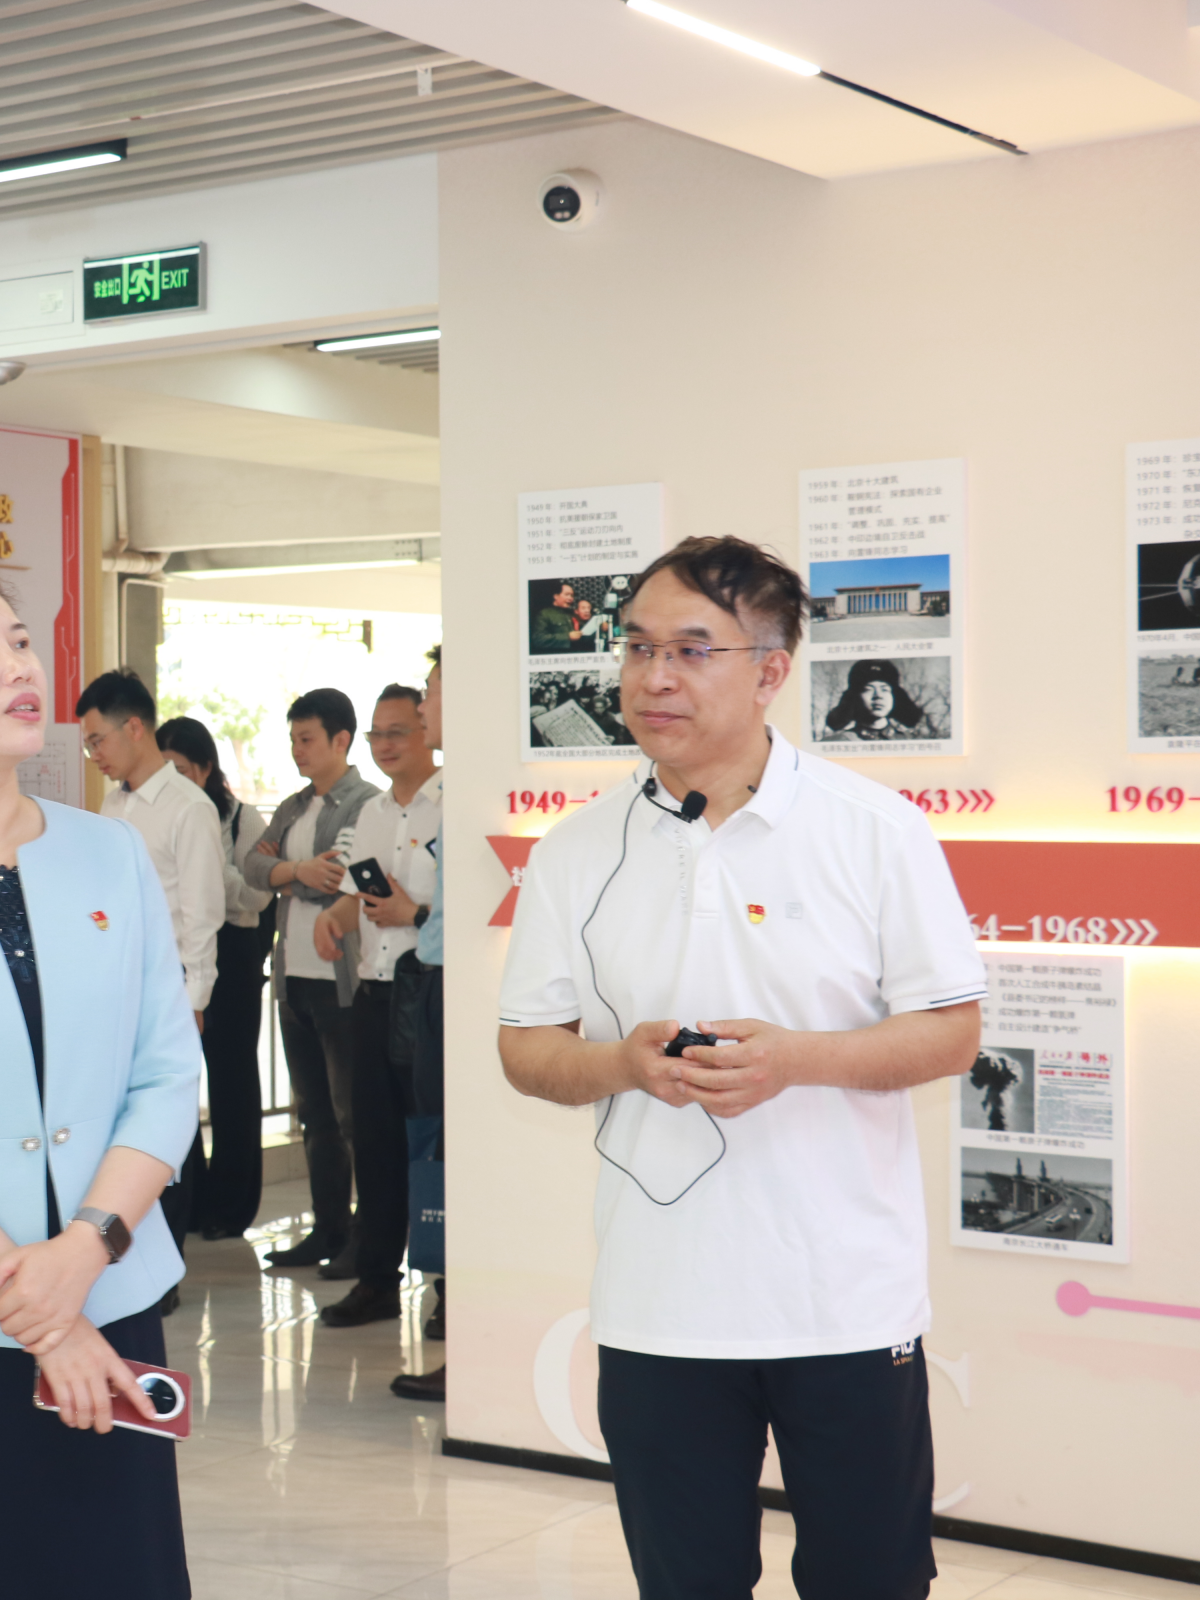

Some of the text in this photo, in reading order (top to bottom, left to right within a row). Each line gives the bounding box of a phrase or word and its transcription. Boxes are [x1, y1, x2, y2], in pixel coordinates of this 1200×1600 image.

[93, 277, 121, 299] 安全出口
[161, 268, 189, 290] EXIT
